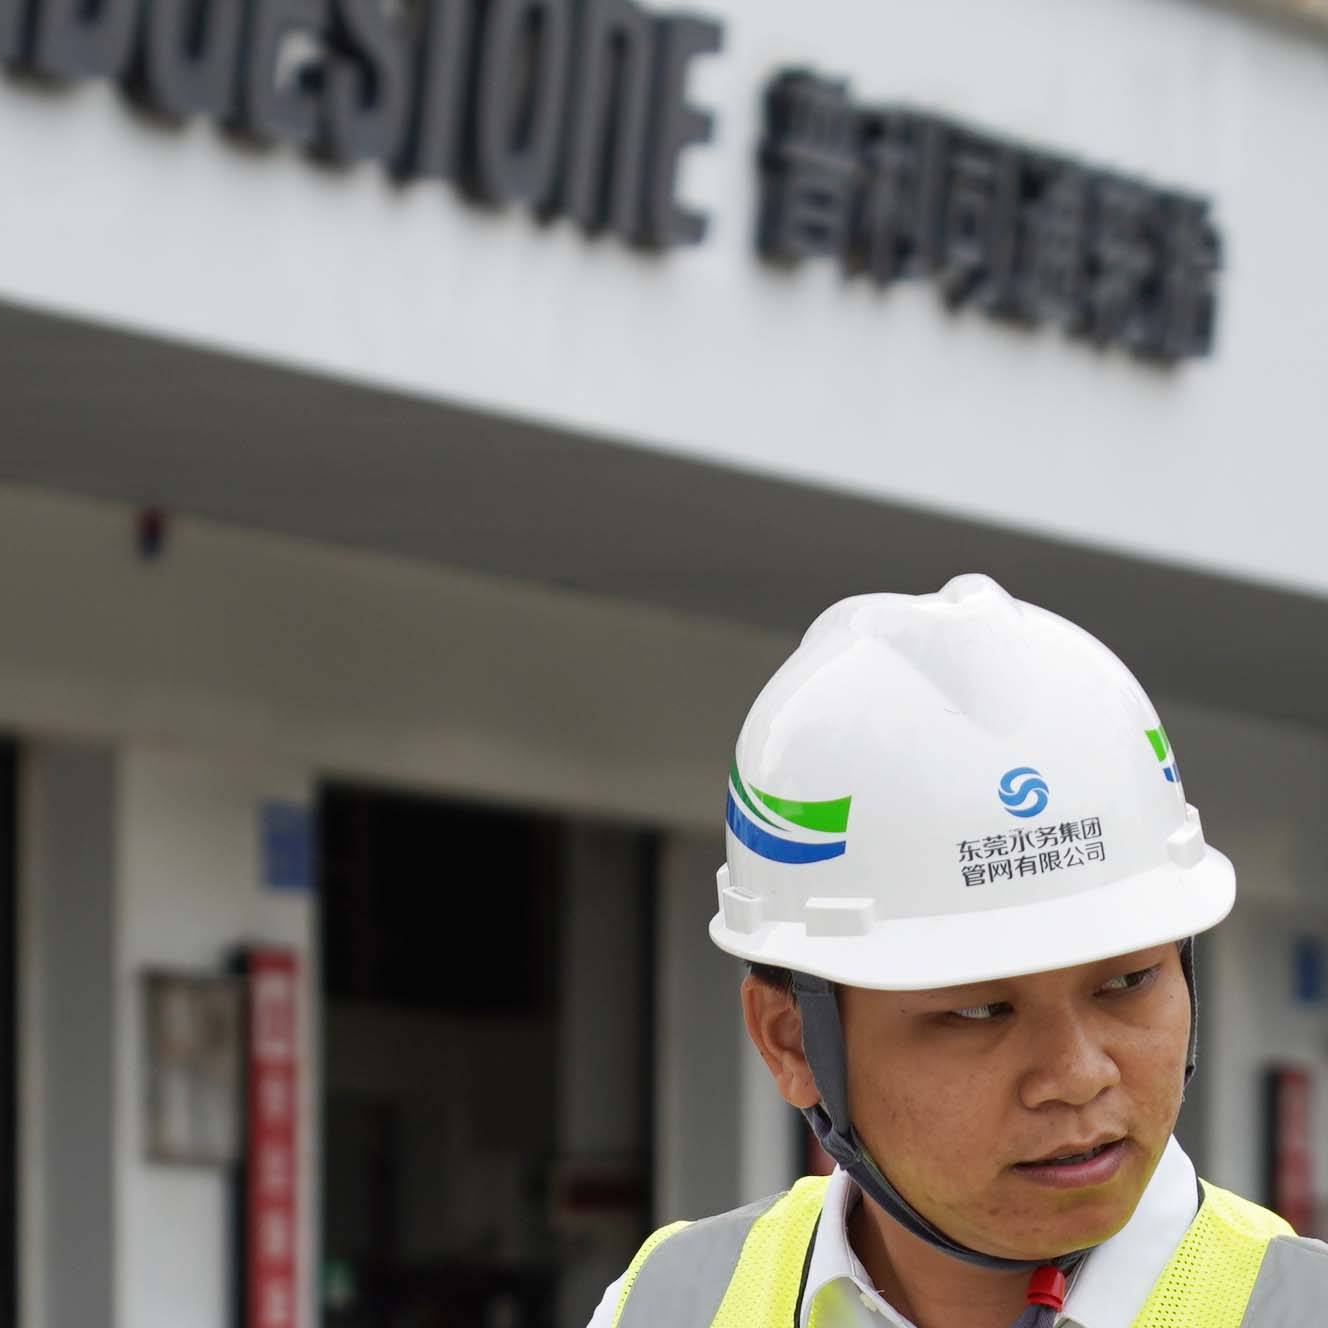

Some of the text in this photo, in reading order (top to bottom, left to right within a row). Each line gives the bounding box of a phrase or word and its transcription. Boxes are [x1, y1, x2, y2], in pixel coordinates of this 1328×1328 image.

[957, 817, 1103, 863] 东莞水务集团
[961, 841, 1106, 887] 管网有限公司
